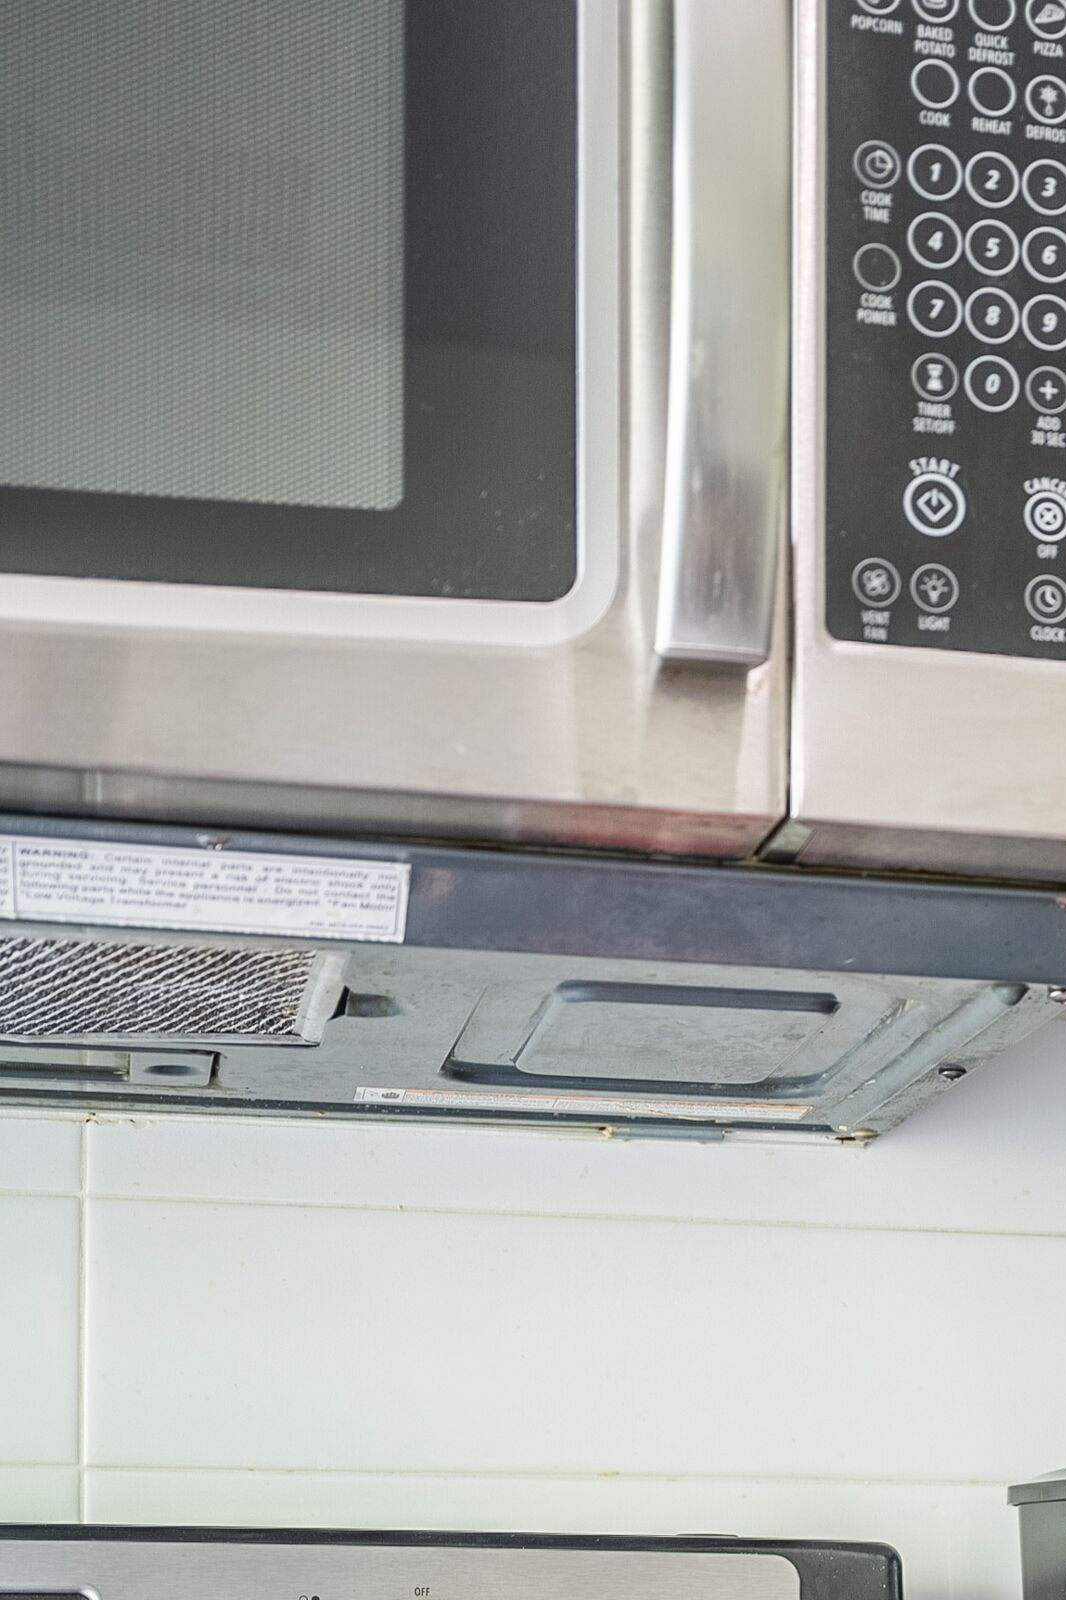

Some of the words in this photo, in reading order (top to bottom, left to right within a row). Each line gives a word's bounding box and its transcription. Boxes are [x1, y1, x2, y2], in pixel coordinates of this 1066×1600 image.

[851, 15, 903, 35] POPCORN
[917, 24, 952, 41] BAKED
[914, 40, 955, 58] POTATO
[975, 33, 1008, 49] QUICK
[1034, 41, 1063, 58] PIZZA
[968, 47, 1015, 66] DEFROST
[919, 111, 951, 127] COOK
[972, 117, 1012, 135] REHEAT
[929, 162, 941, 182] 1
[984, 170, 1000, 190] 2
[1042, 177, 1056, 197] 3
[861, 190, 893, 207] COOK
[863, 206, 891, 223] TIME
[927, 231, 943, 251] 4
[985, 238, 1000, 258] 5
[1042, 245, 1057, 265] 6
[860, 293, 893, 309] COOK
[929, 299, 944, 319] 7
[856, 309, 897, 326] POWER
[985, 306, 1000, 326] 8
[1042, 313, 1057, 332] 9
[984, 373, 1000, 394] 0
[917, 401, 951, 418] TIMER
[1036, 416, 1061, 431] ADD
[1030, 430, 1045, 446] 30
[1046, 431, 1066, 448] SEC
[909, 457, 960, 478] START
[861, 609, 891, 625] VENT
[917, 615, 950, 631] LIGHT
[864, 625, 887, 641] FAN
[1030, 625, 1066, 642] CLOCK
[414, 1587, 431, 1597] OFF
